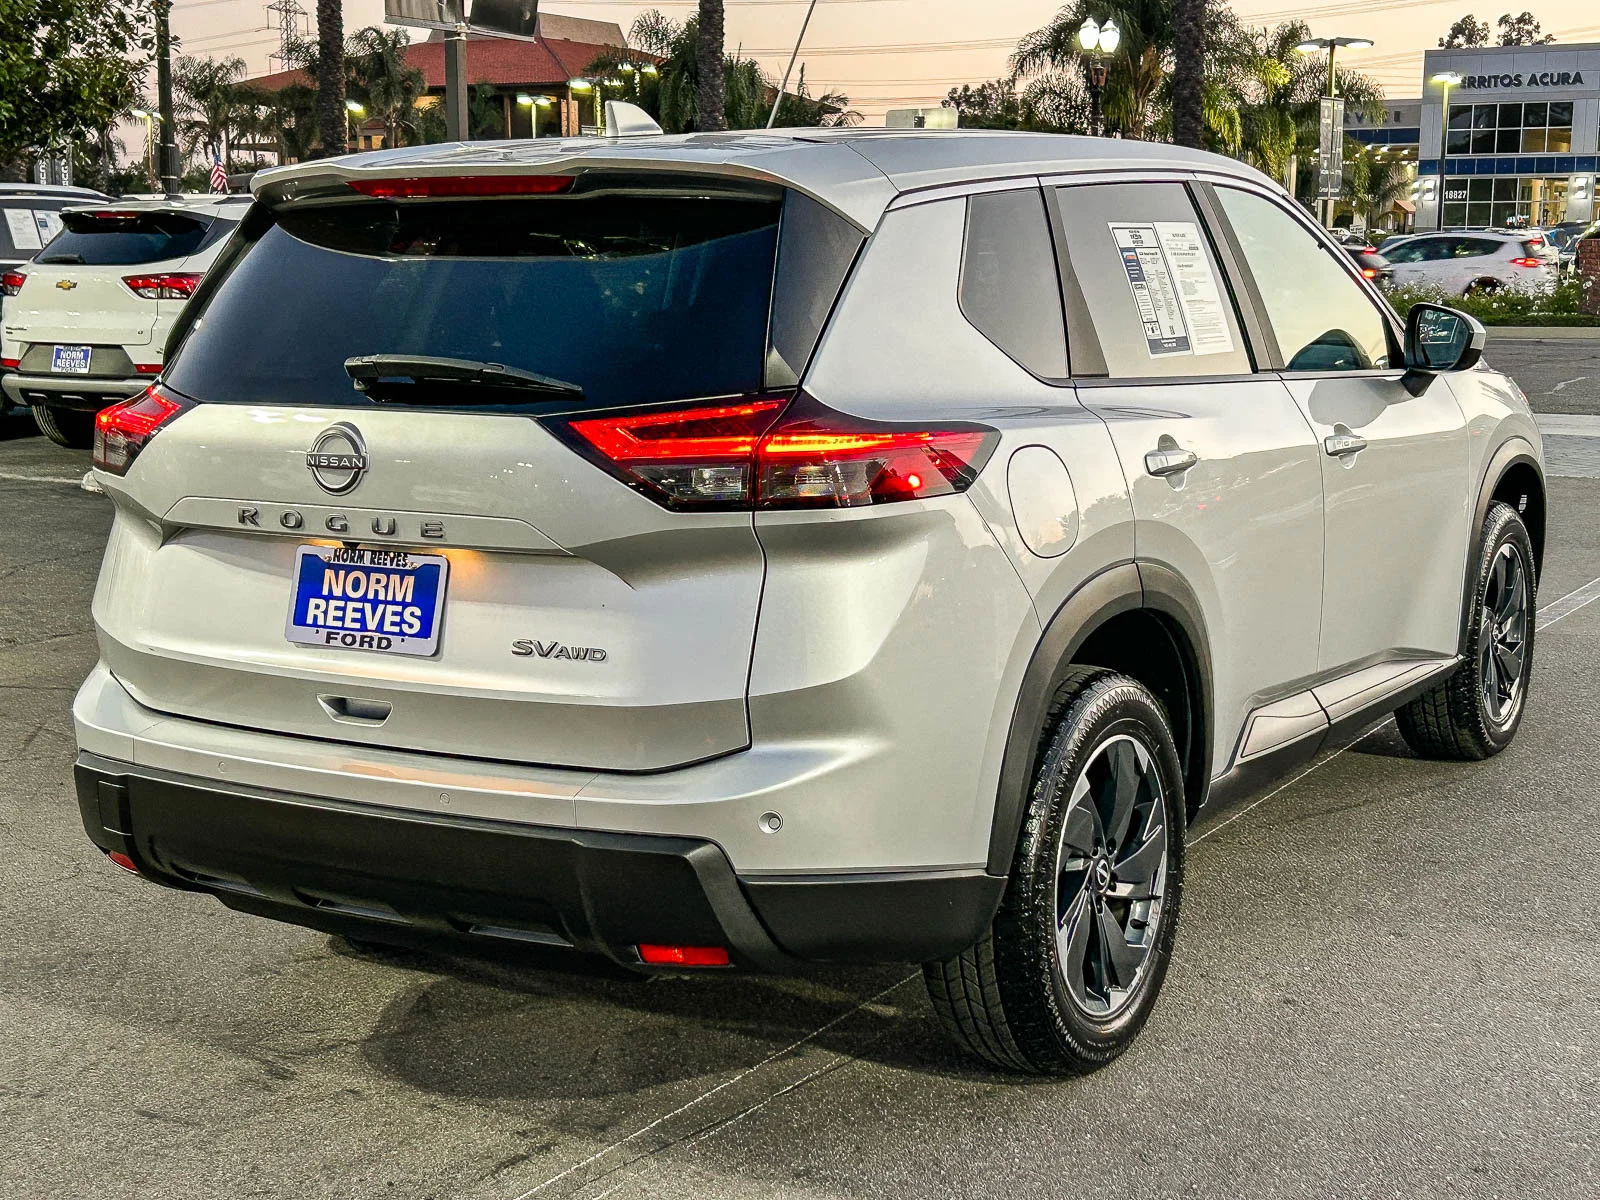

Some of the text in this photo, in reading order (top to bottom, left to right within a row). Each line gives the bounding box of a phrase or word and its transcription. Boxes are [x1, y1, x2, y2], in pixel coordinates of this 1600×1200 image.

[1460, 71, 1584, 89] ERRITOS ACURA
[56, 359, 86, 368] REEVES
[60, 351, 84, 360] NORM
[307, 455, 363, 468] NISSAN
[236, 506, 447, 539] ROGUE
[332, 548, 409, 568] NORM REEVES
[322, 569, 415, 603] NORM
[306, 598, 422, 634] REEVES
[325, 630, 393, 651] FORD
